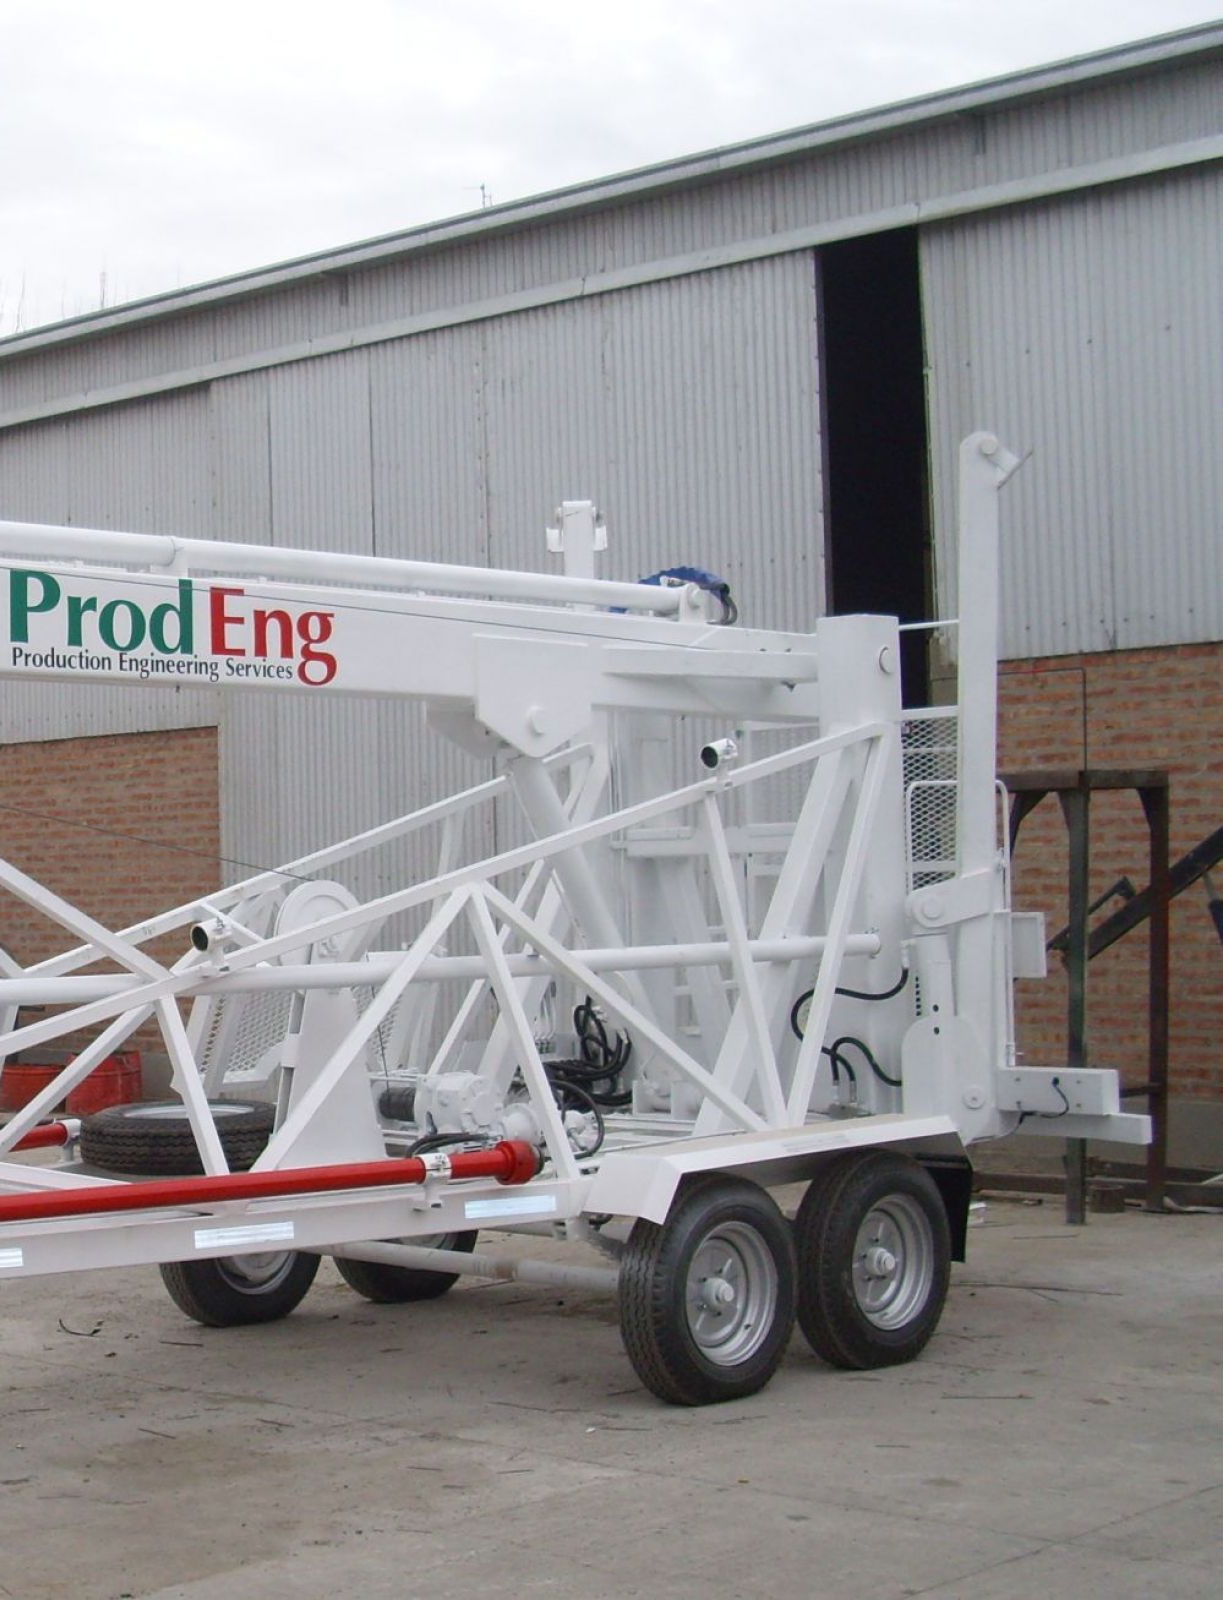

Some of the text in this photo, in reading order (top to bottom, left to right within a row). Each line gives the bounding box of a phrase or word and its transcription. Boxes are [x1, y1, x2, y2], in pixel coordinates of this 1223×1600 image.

[9, 568, 338, 686] ProdEng
[12, 647, 293, 683] Production Engineering Services
